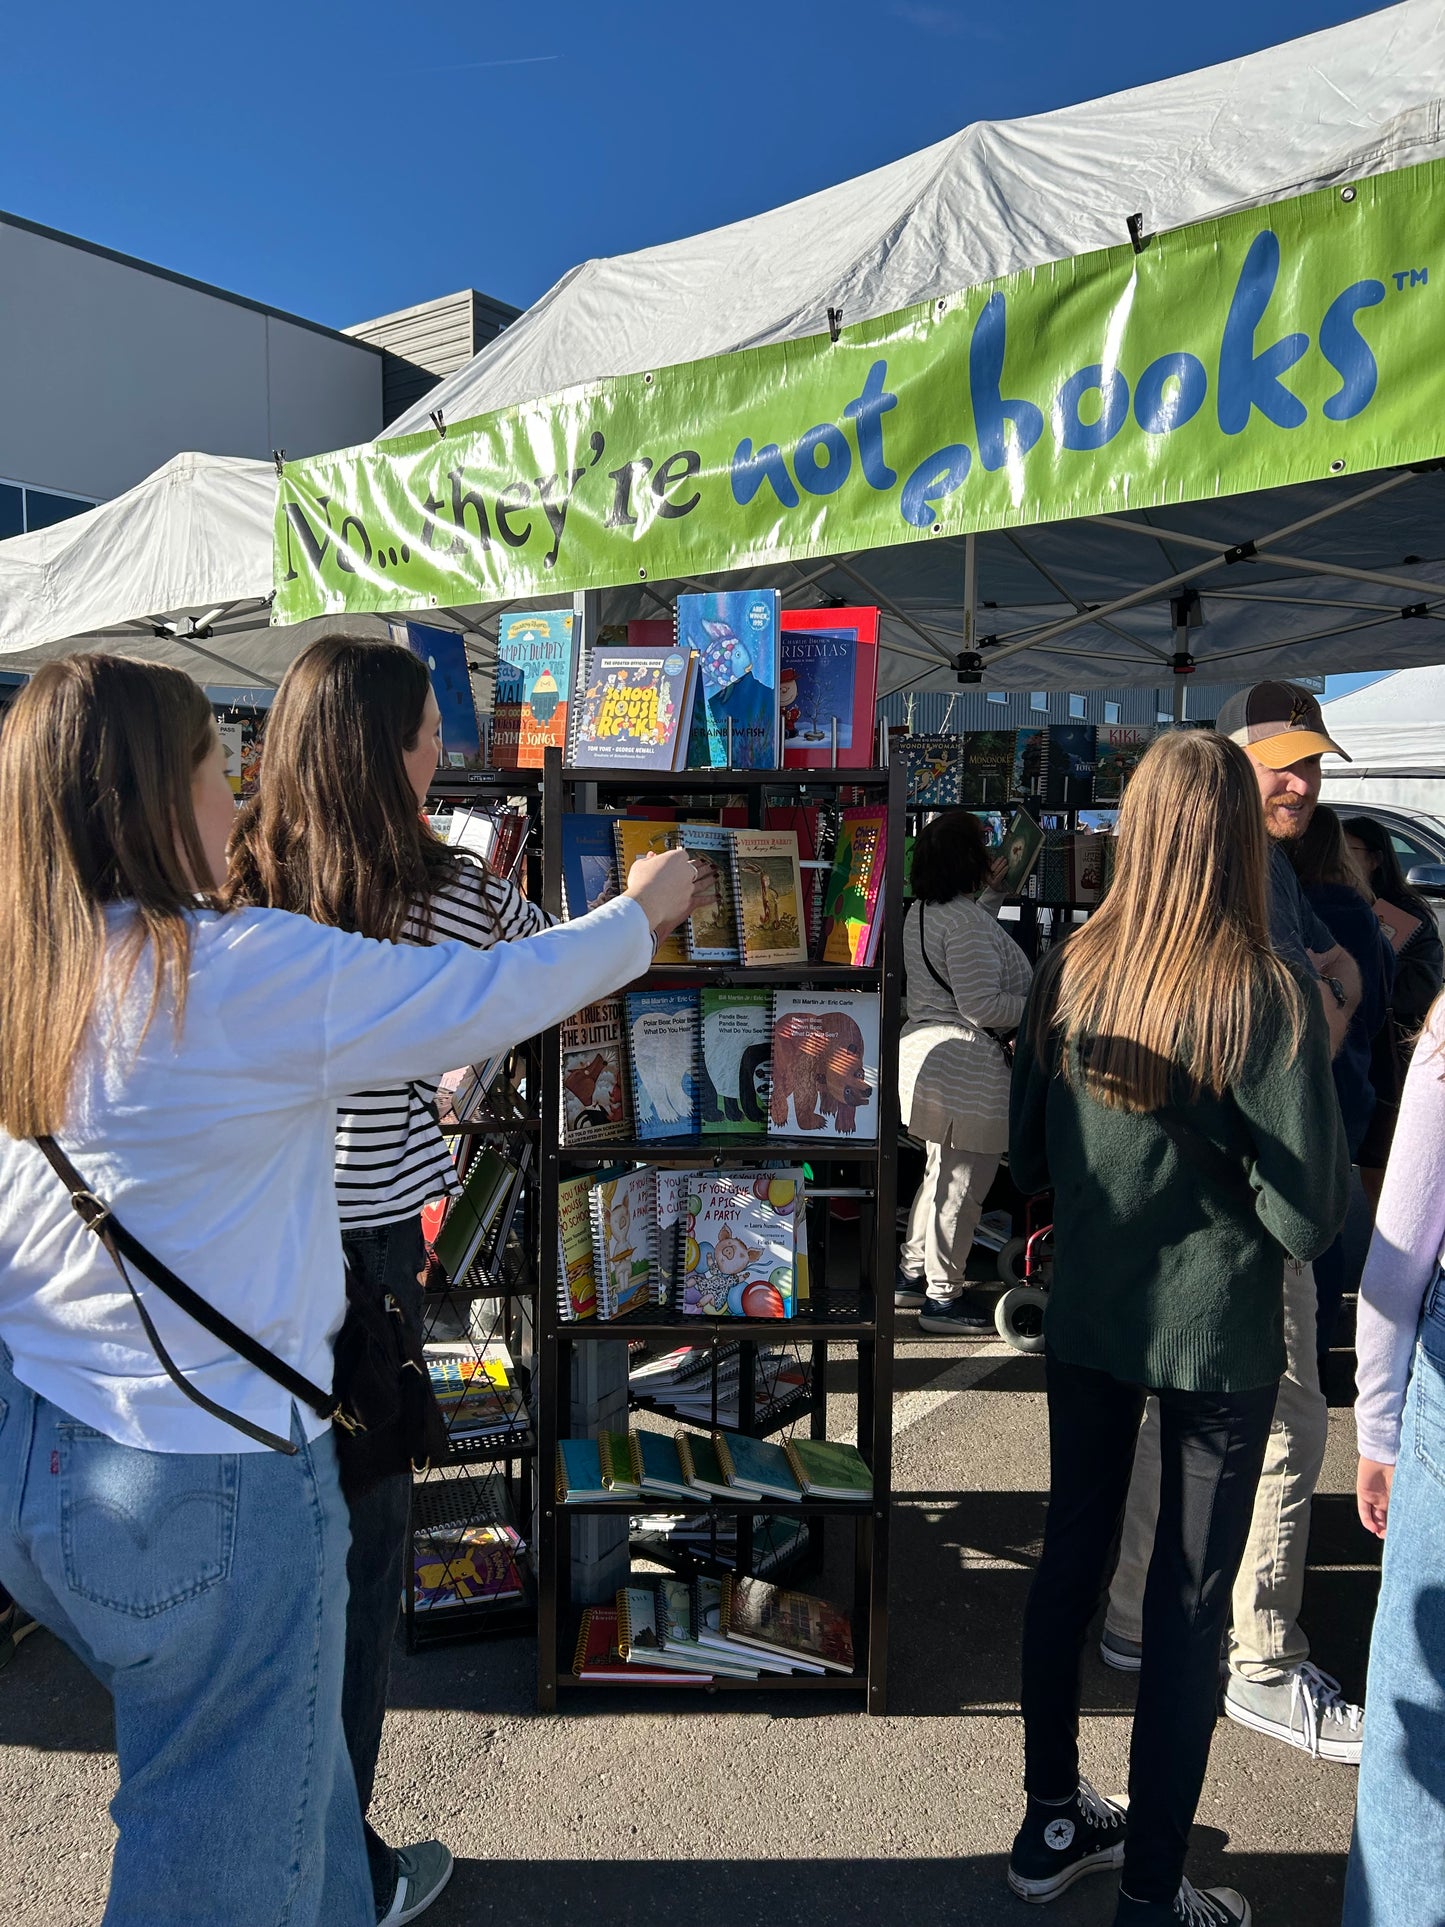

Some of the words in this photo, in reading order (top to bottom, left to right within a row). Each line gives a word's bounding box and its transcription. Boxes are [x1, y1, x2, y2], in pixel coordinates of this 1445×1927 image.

[530, 642, 565, 661] DUMPTY
[781, 643, 848, 658] RISTMAS
[606, 686, 659, 702] SCHOOL
[602, 700, 659, 719] HOUSE
[526, 732, 556, 747] SONGS
[747, 727, 765, 737] FISH
[580, 1006, 601, 1025] TRUE
[672, 1017, 686, 1025] Polar
[718, 1014, 734, 1022] Panda
[718, 1021, 735, 1029] Panda
[562, 1029, 579, 1048] THE
[580, 1028, 587, 1045] 3
[588, 1023, 618, 1043] LITTLE
[561, 1189, 574, 1202] YOU
[574, 1181, 589, 1196] TAKE
[697, 1182, 707, 1194] IF
[709, 1182, 727, 1194] YOU
[727, 1184, 750, 1197] GIVE
[562, 1198, 584, 1217] MOUSE
[709, 1197, 717, 1208] A
[718, 1196, 736, 1208] PIG
[704, 1210, 711, 1221] A
[713, 1210, 741, 1221] PARTY
